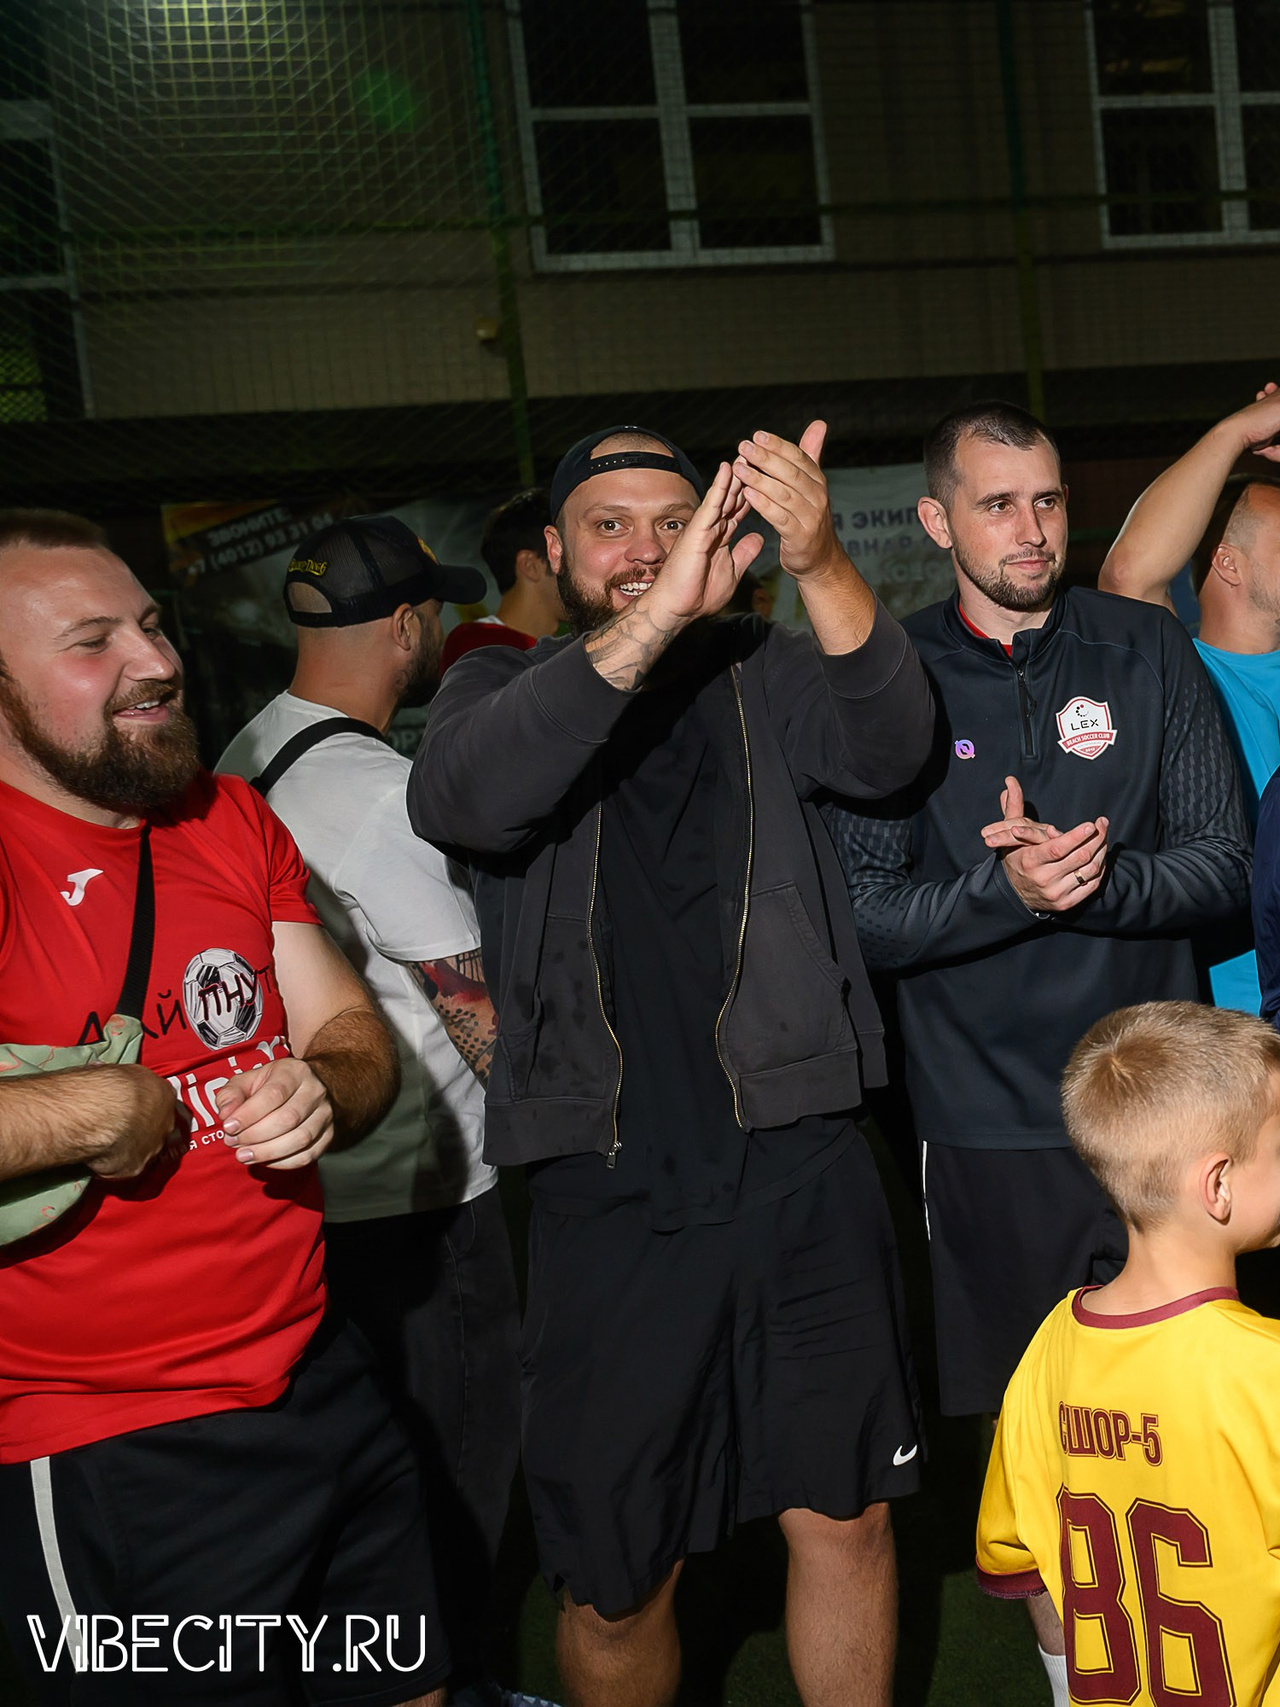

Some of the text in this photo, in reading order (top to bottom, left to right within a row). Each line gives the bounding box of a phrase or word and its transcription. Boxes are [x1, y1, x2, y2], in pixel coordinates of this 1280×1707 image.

[851, 507, 920, 531] ЭКИП
[1066, 736, 1081, 747] BEACH
[1081, 733, 1098, 742] SOCCER
[1098, 732, 1110, 740] CLUB
[1070, 718, 1099, 731] LEX
[199, 965, 272, 1023] ПНУТ
[1059, 1401, 1163, 1468] СШОР-5
[1056, 1482, 1238, 1707] 86
